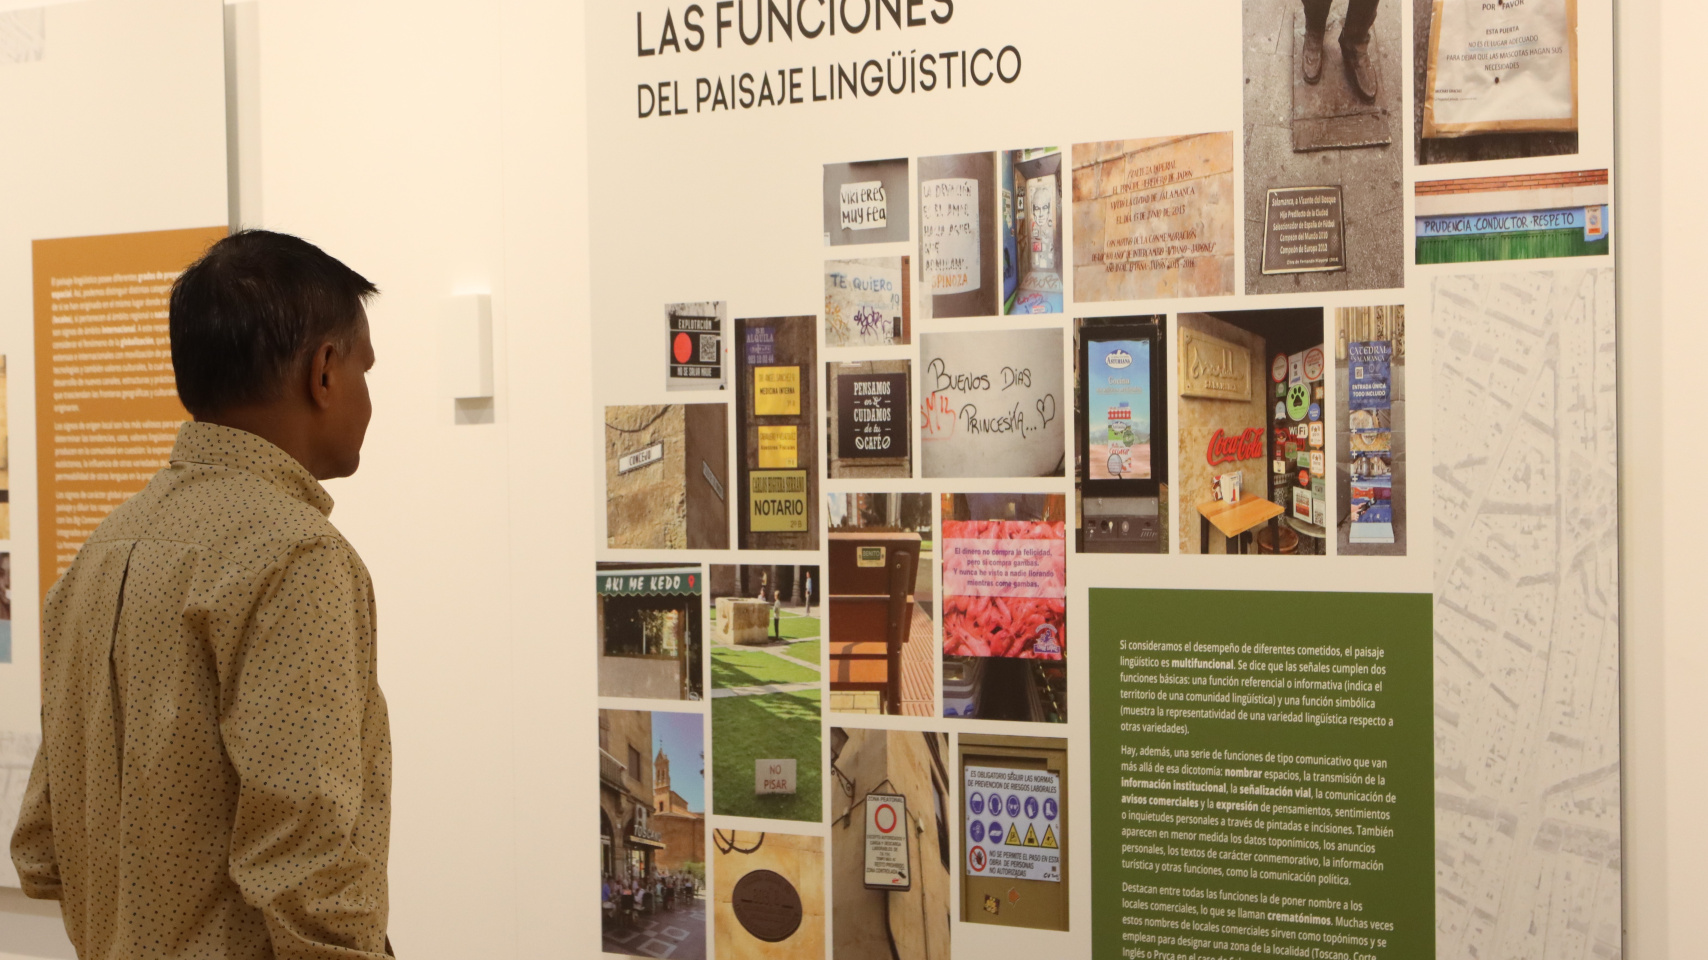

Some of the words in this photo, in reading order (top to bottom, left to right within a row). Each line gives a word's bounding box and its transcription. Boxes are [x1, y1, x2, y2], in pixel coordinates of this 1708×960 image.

[1502, 0, 1525, 9] FAVOR
[637, 4, 705, 58] LAS
[716, 0, 955, 49] FUNCIONES
[1499, 26, 1519, 34] PUERTA
[1490, 39, 1507, 47] LUGAR
[1508, 35, 1538, 45] ADECUADO
[1477, 53, 1488, 61] QUE
[1489, 52, 1499, 60] LAS
[1499, 49, 1529, 60] MASCOTAS
[1529, 48, 1551, 57] HAGAN
[1552, 46, 1562, 55] SUS
[1484, 62, 1520, 71] NECESIDADES
[637, 81, 689, 119] DEL
[696, 69, 804, 113] PAISAJE
[811, 45, 1022, 102] LINGÜÍSTICO
[1321, 195, 1336, 205] Bosque
[842, 209, 864, 225] MUY
[830, 273, 846, 289] TE
[931, 273, 968, 289] SPINOZA
[678, 318, 712, 330] EXPLOTACIÓN
[746, 333, 774, 343] ALQUILA
[1349, 345, 1388, 356] CATEDRAL
[677, 366, 683, 376] NO
[683, 367, 688, 377] SE
[928, 357, 991, 394] BUENOS
[759, 387, 778, 395] MEDICINA
[779, 387, 795, 395] INTERNA
[853, 381, 891, 396] PENSAMOS
[853, 407, 892, 423] CUIDAMOS
[864, 433, 882, 450] CAFÉ
[629, 448, 651, 466] CONCEJO
[754, 499, 803, 516] NOTARIO
[862, 549, 880, 558] BENITO
[954, 548, 960, 556] El
[962, 548, 981, 556] dinero
[992, 549, 1015, 558] compra
[1023, 548, 1053, 557] felicidad,
[967, 560, 980, 568] pero
[989, 560, 1012, 568] compra
[1013, 559, 1040, 568] gambas.
[979, 569, 987, 577] he
[988, 569, 1003, 577] visto
[1010, 569, 1027, 577] nadie
[1028, 570, 1054, 578] llorando
[605, 577, 623, 592] AKI
[629, 576, 644, 591] ME
[650, 575, 681, 591] KEDO
[967, 579, 994, 587] mientras
[1013, 580, 1040, 589] gambas.
[1120, 638, 1127, 650] Si
[1128, 638, 1183, 651] consideramos
[1184, 640, 1191, 651] el
[1193, 640, 1240, 655] desempeño
[1241, 641, 1252, 653] de
[1253, 642, 1295, 654] diferentes
[1297, 643, 1342, 658] cometidos,
[1344, 644, 1352, 656] el
[1354, 644, 1384, 659] paisaje
[1120, 720, 1141, 732] otras
[1142, 721, 1189, 737] variedades).
[769, 764, 782, 775] NO
[970, 770, 977, 778] ES
[977, 770, 1006, 780] OBLIGATORIO
[1007, 772, 1023, 782] SEGUIR
[1024, 774, 1033, 782] LAS
[1034, 775, 1053, 784] NORMAS
[764, 779, 787, 791] PISAR
[967, 779, 974, 787] DE
[975, 780, 1002, 789] PREVENCION
[1003, 782, 1010, 790] DE
[1011, 782, 1030, 791] RIESGOS
[1030, 784, 1057, 794] LABORALES
[1121, 776, 1171, 790] información
[1173, 779, 1228, 796] institucional,
[1230, 782, 1237, 794] la
[1239, 782, 1293, 797] señalización
[1294, 785, 1313, 801] vial,
[1316, 787, 1323, 798] la
[1325, 787, 1383, 802] comunicación
[1385, 790, 1396, 802] de
[634, 824, 662, 843] TOSCANO
[996, 850, 1002, 858] SE
[1003, 851, 1022, 860] PERMITE
[1022, 852, 1027, 860] EL
[1028, 853, 1040, 861] PASO
[1040, 854, 1047, 862] EN
[1048, 855, 1059, 863] ESTA
[989, 858, 1002, 866] OBRA
[1003, 859, 1009, 867] DE
[1010, 860, 1034, 870] PERSONAS
[997, 867, 1027, 878] AUTORIZADAS
[1122, 897, 1149, 910] locales
[1150, 899, 1199, 917] comerciales,
[1200, 903, 1208, 915] lo
[1210, 907, 1225, 919] que
[1227, 908, 1236, 917] se
[1238, 906, 1265, 920] llaman
[1267, 909, 1333, 925] crematónimos.
[1335, 914, 1368, 928] Muchas
[1370, 920, 1394, 930] veces
